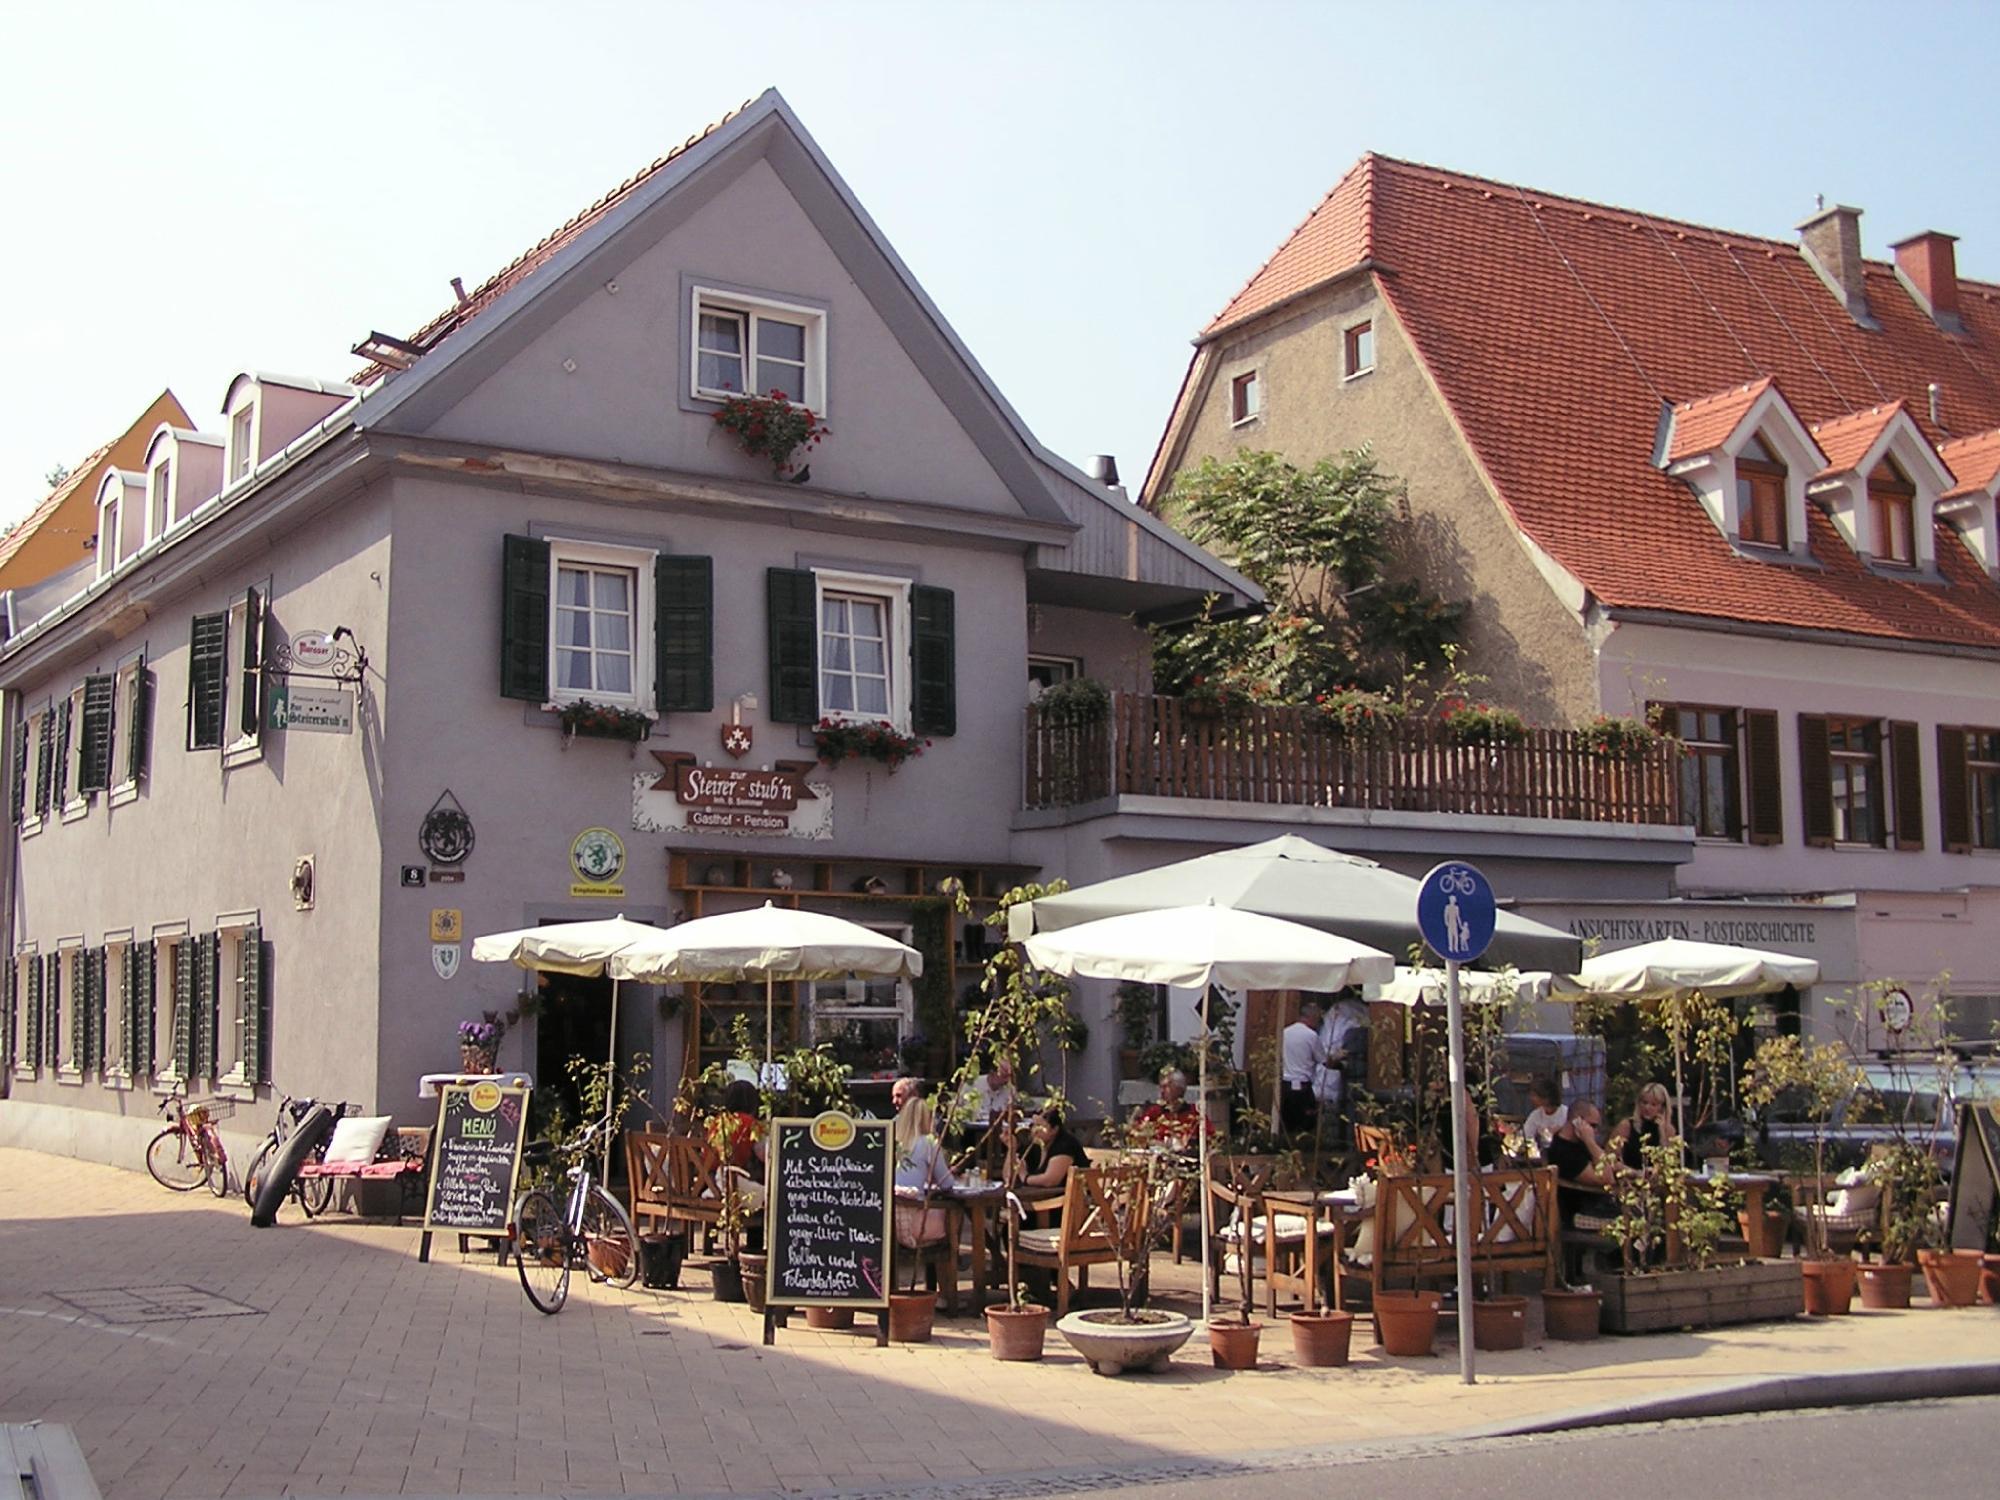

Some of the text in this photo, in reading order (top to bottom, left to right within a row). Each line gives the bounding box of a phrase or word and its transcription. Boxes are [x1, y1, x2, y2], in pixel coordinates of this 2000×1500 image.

[730, 771, 747, 780] zur
[684, 770, 738, 801] Steirer
[748, 776, 792, 800] stub'n
[693, 812, 733, 826] Gasthof
[744, 814, 784, 828] Pension
[410, 868, 418, 880] 8
[1567, 919, 1690, 941] ANSICHTSKARTEN
[1704, 921, 1816, 943] POSTGESCHICHTE
[787, 1208, 844, 1226] dazu ein
[849, 1227, 882, 1244] Mais-
[828, 1250, 857, 1268] und
